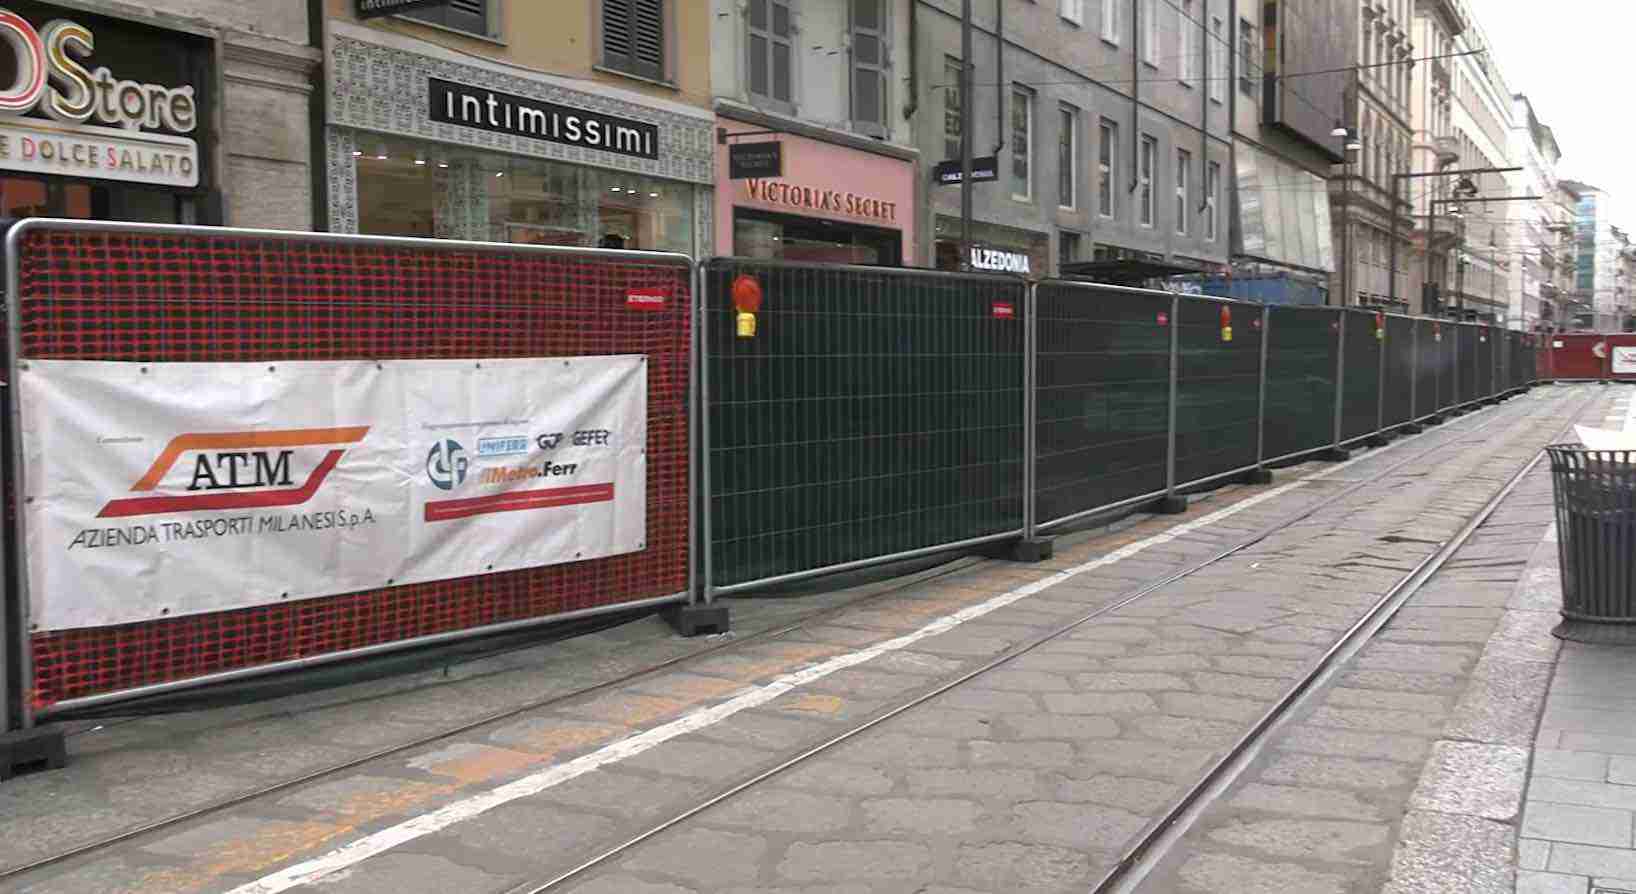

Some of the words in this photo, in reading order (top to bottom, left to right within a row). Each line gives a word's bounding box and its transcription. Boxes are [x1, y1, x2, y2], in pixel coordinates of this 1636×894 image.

[21, 136, 99, 168] DOLCE
[105, 146, 193, 176] SALATO
[746, 178, 841, 213] VICTORIA'S
[844, 192, 897, 221] SECRET
[187, 450, 294, 490] ATM
[68, 525, 159, 550] AZIENDA
[160, 517, 252, 542] TRASPORTI
[258, 511, 335, 534] MILANESI
